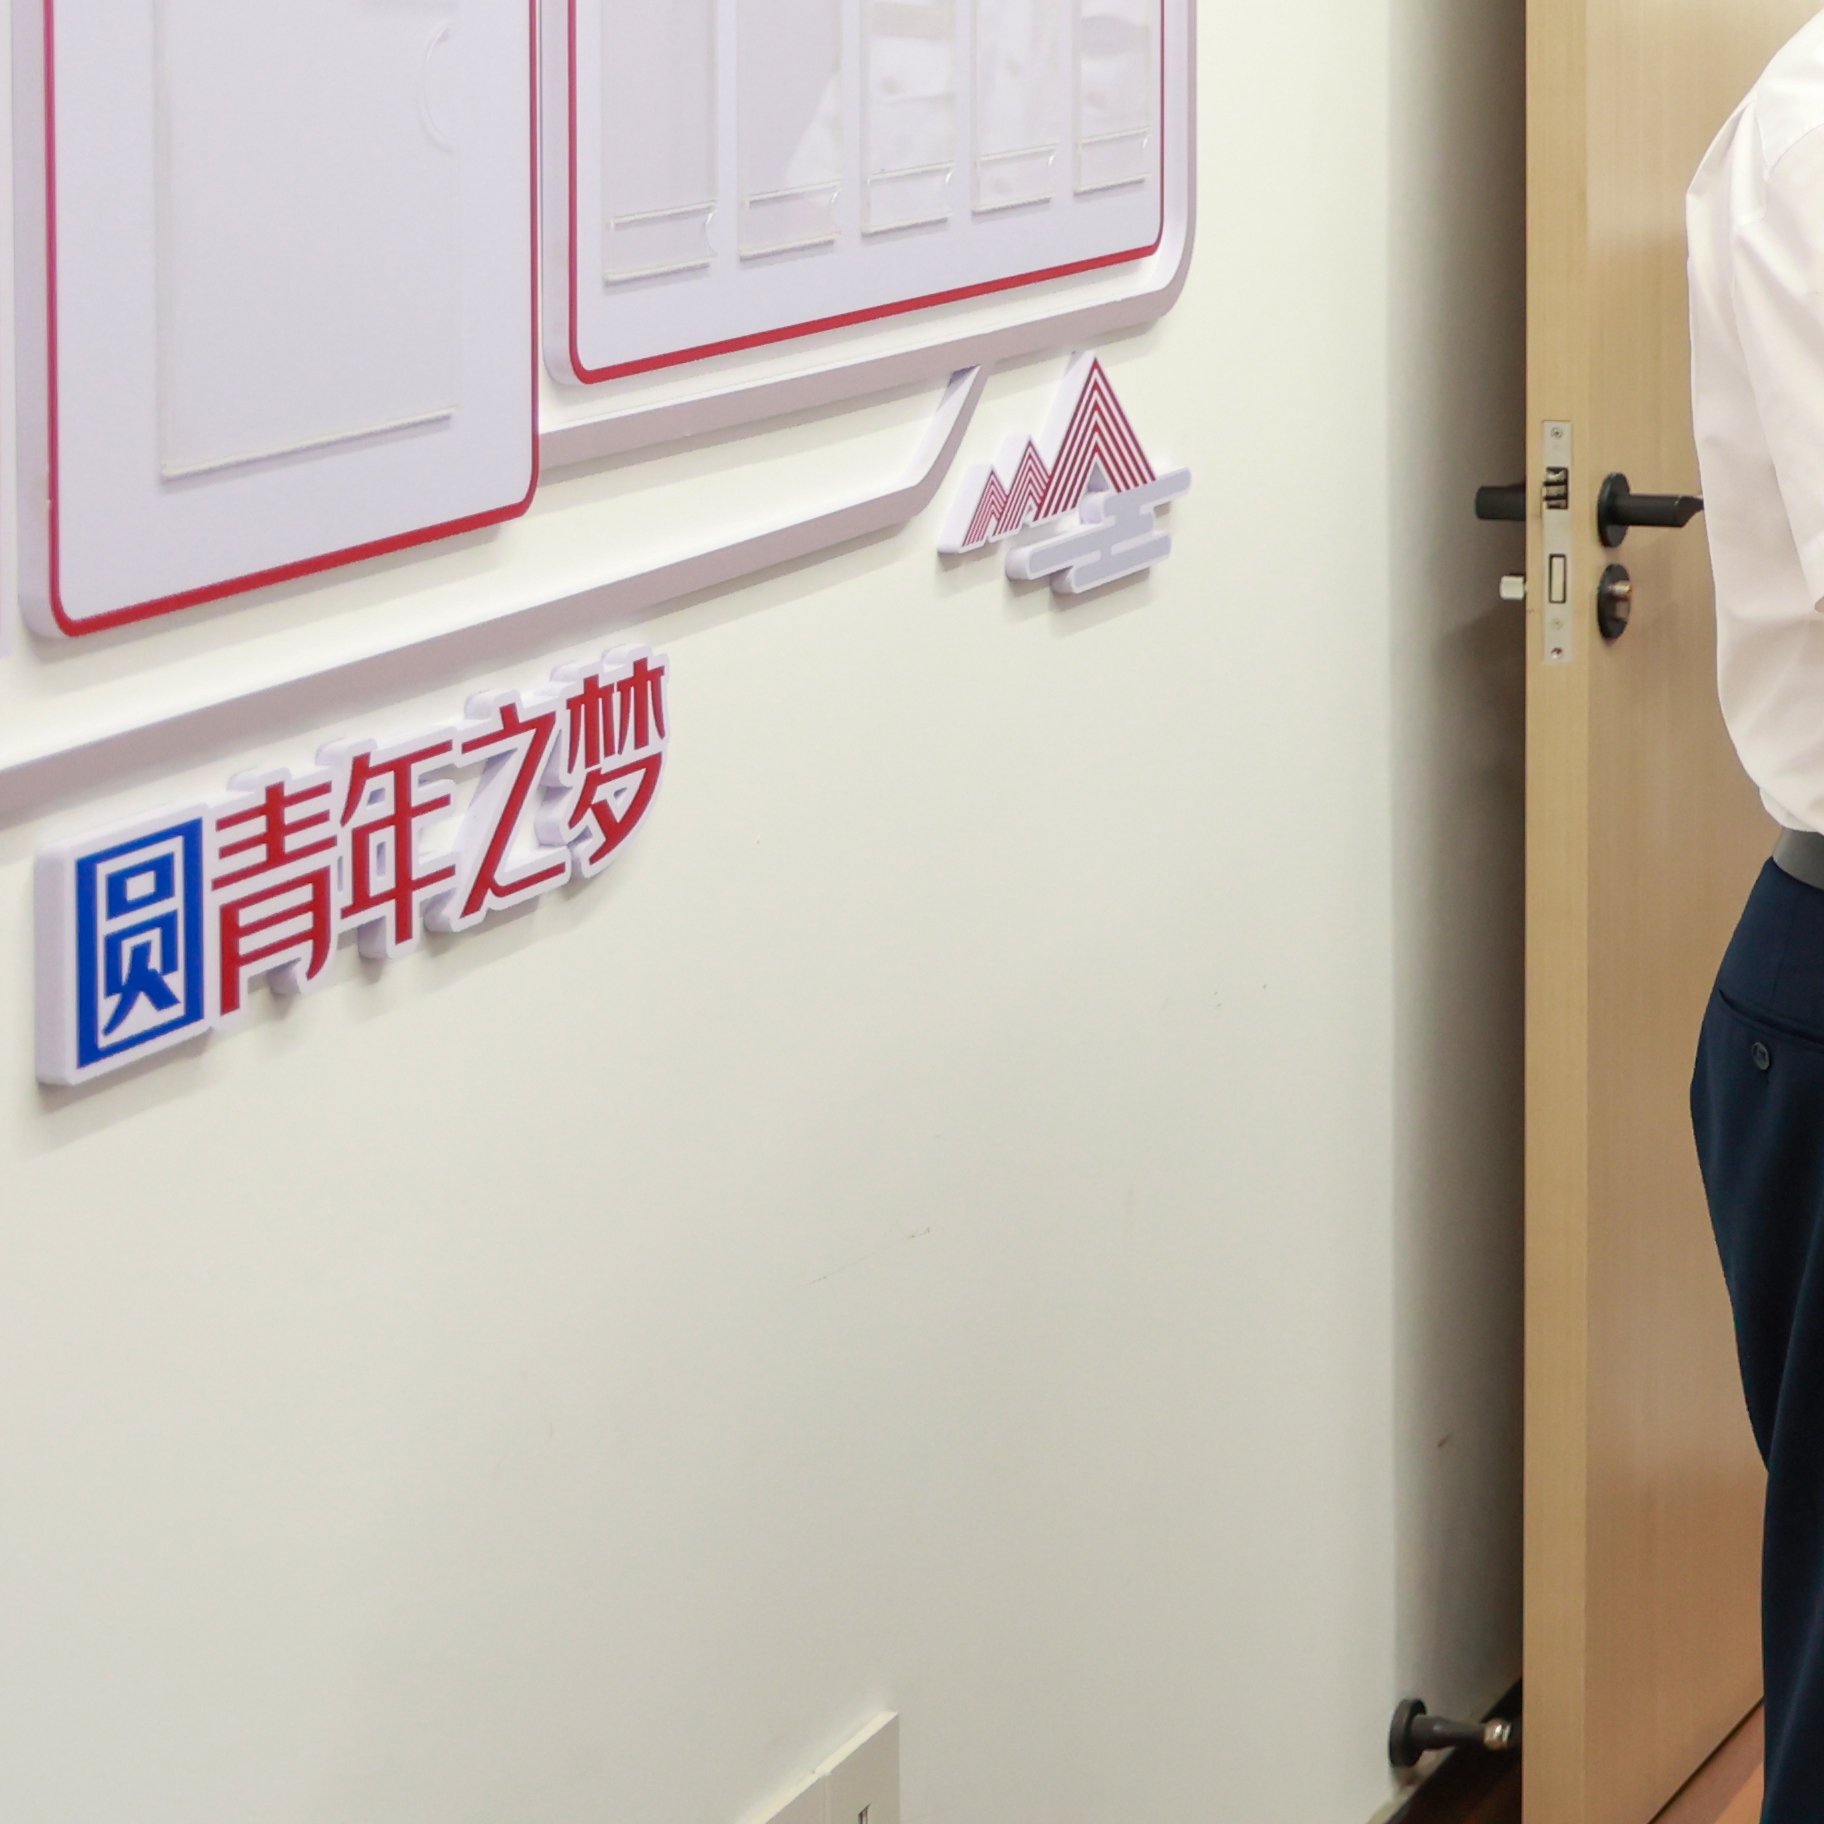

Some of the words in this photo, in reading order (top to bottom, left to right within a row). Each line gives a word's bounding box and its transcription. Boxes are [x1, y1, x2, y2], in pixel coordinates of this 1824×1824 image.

[75, 654, 668, 1071] 圆青年之梦
